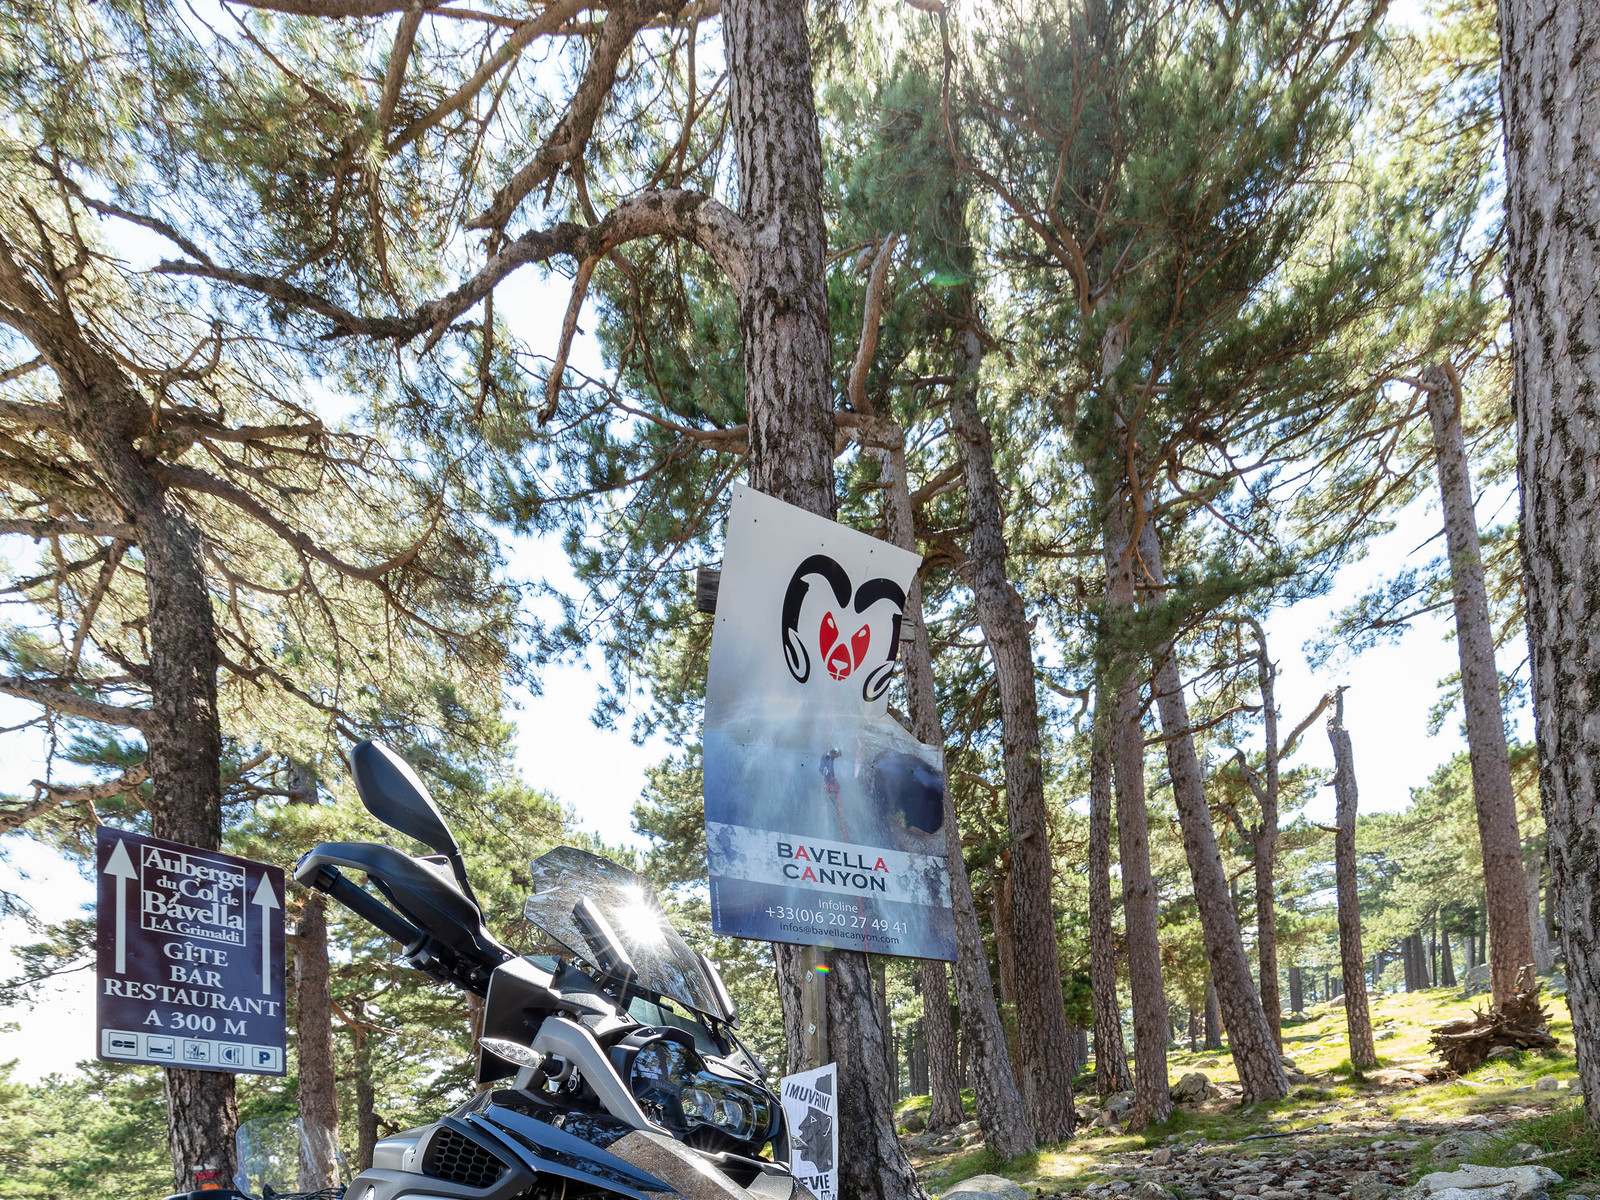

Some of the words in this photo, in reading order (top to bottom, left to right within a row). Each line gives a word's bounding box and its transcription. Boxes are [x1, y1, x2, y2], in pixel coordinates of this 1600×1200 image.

[144, 849, 245, 892] Auberge
[777, 842, 889, 873] BAVELLA
[156, 875, 178, 890] du
[178, 878, 219, 903] Col
[222, 894, 239, 907] de
[783, 864, 886, 892] CANYON
[142, 890, 244, 931] Bavella
[765, 906, 824, 924] +33(0)6
[829, 913, 846, 927] 20
[850, 916, 867, 929] 27
[871, 919, 889, 932] 49
[892, 922, 908, 934] 41
[818, 899, 859, 914] Infoline
[176, 921, 240, 943] Grimaldi
[779, 922, 900, 944] infos@bavellacanyon.com
[163, 941, 229, 967] GÎTE
[169, 965, 223, 988] BAR
[103, 978, 280, 1017] RESTAURANT
[142, 1009, 163, 1027] A
[170, 1012, 216, 1032] 300
[223, 1018, 248, 1036] M
